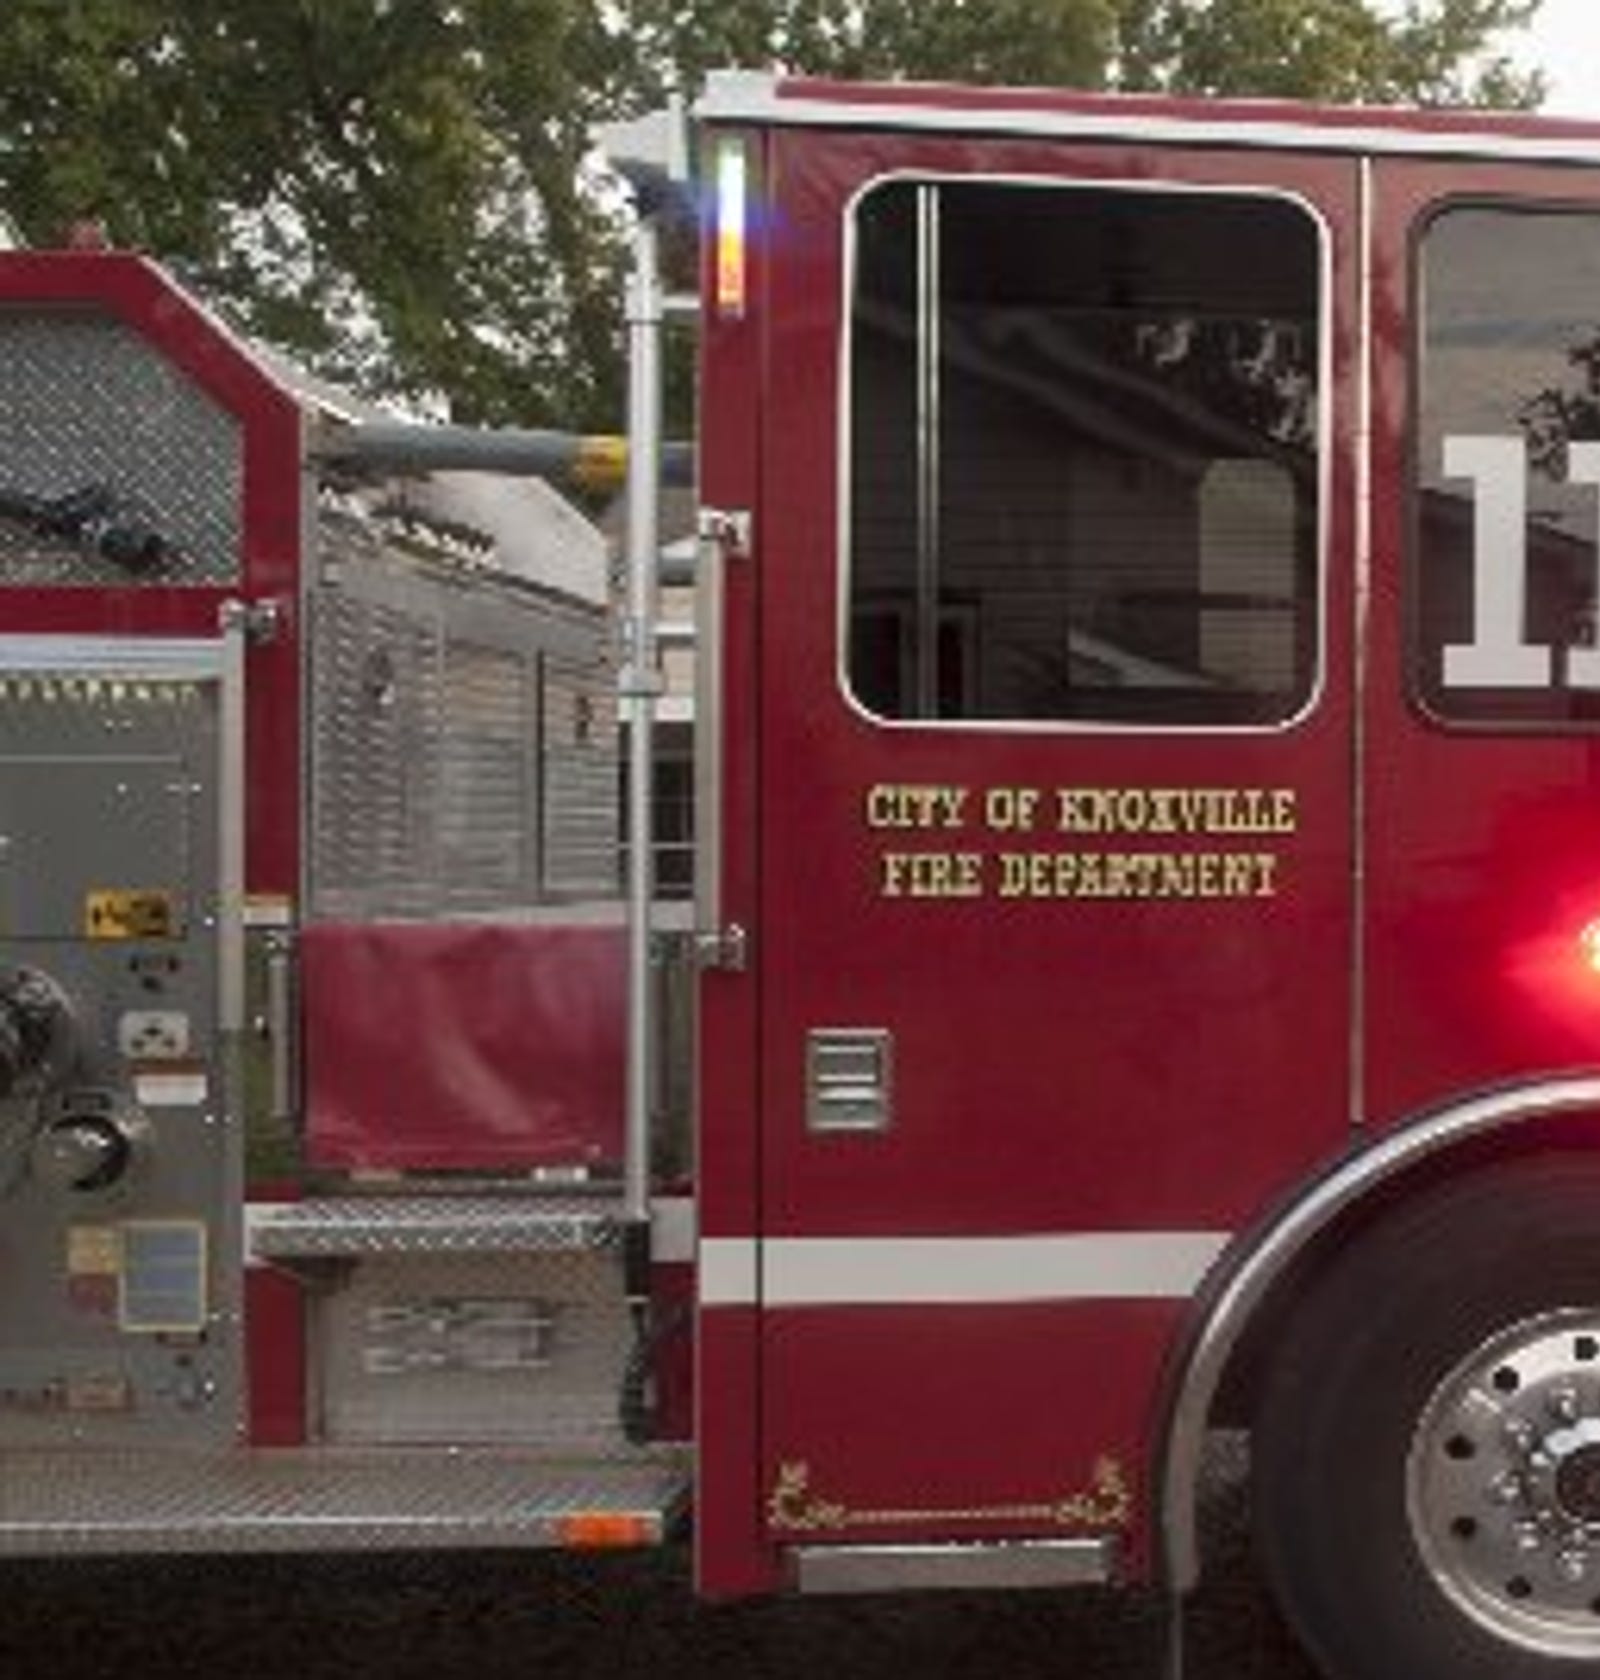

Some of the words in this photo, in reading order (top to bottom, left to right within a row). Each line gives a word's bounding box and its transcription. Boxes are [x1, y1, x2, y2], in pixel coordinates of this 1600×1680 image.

[867, 784, 967, 828] CITY
[986, 788, 1039, 830] OF
[1059, 788, 1296, 832] KNOXVILLE
[882, 853, 982, 897] FIRE
[1000, 853, 1276, 897] DEPARTMENT
